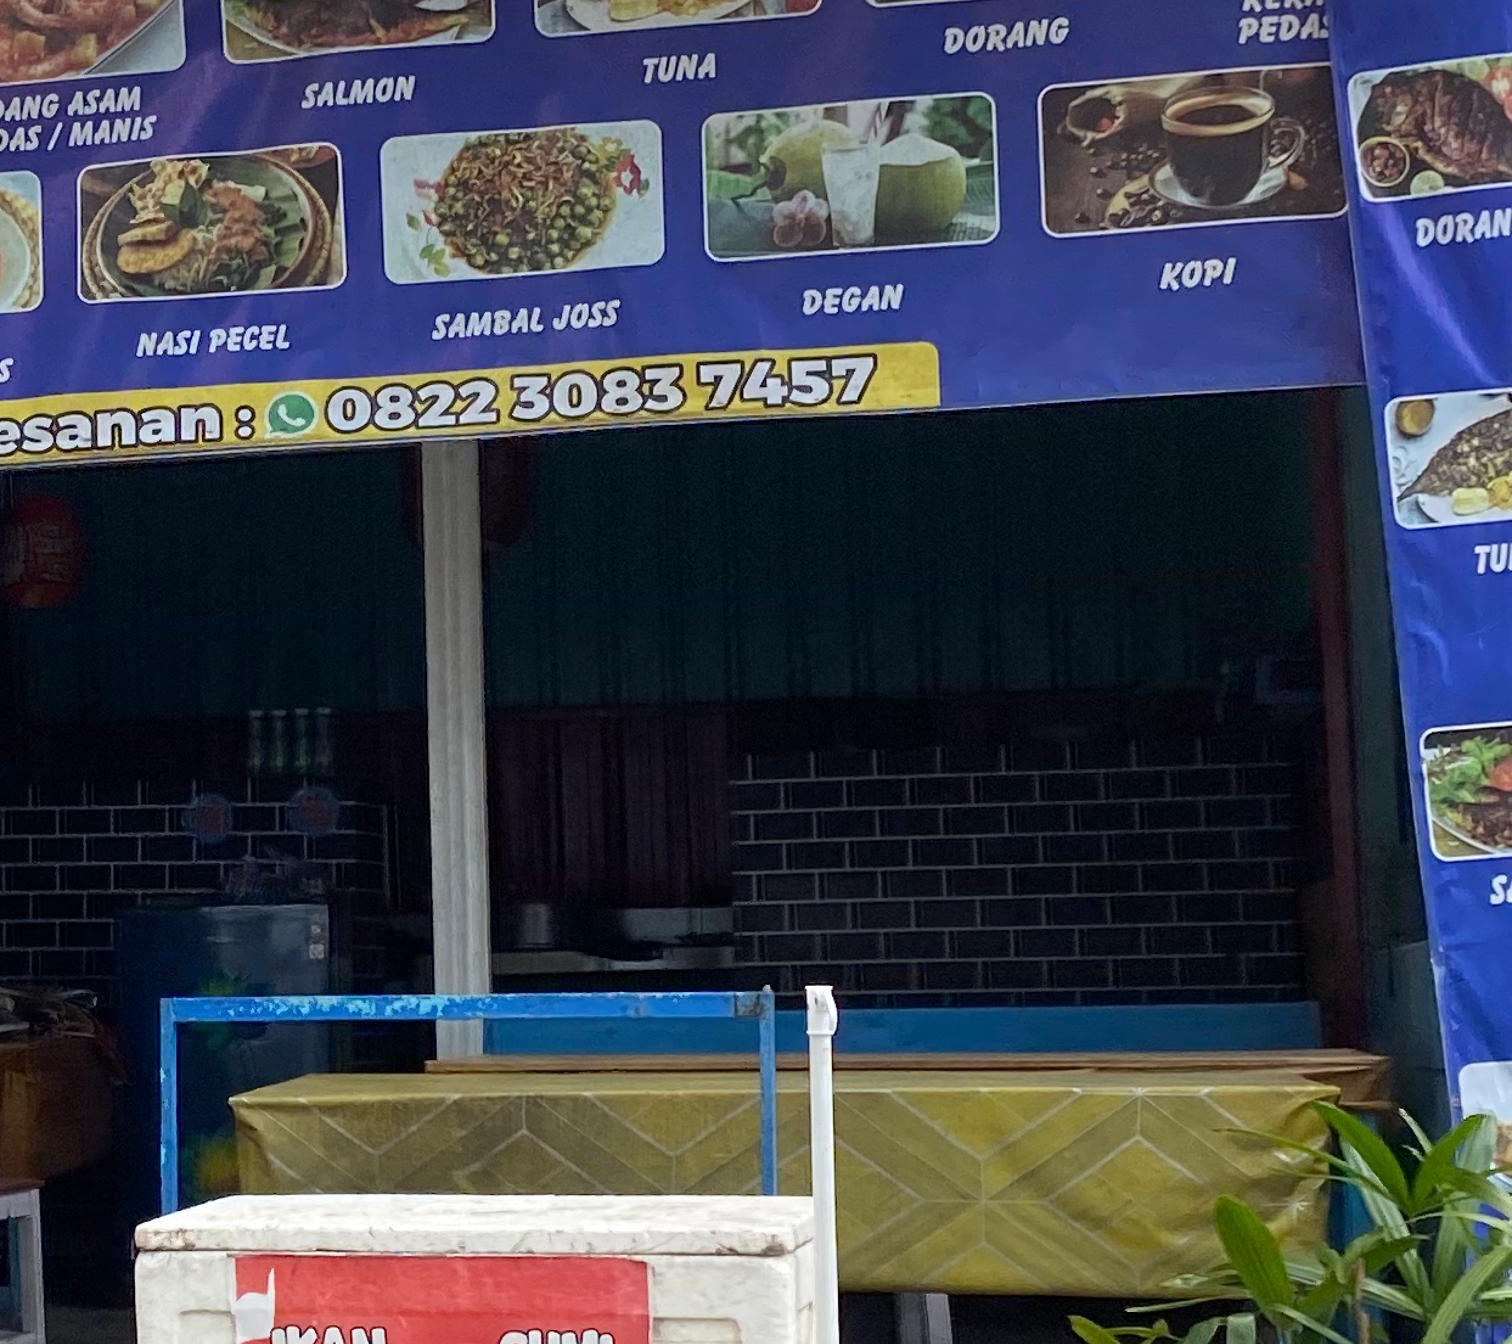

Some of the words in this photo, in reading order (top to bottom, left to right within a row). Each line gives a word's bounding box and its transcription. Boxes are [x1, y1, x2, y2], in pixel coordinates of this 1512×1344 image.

[944, 17, 1069, 54] DORANG
[643, 53, 717, 84] TUNA
[67, 86, 142, 115] ASAM
[301, 74, 415, 109] SALMON
[68, 115, 157, 148] MANIS
[1415, 207, 1512, 248] DORAN
[1158, 258, 1236, 292] KOPI
[802, 284, 904, 316] DEGAN
[431, 309, 544, 342] SAMBAL
[553, 299, 621, 330] JOSS
[136, 329, 200, 358] NASI
[209, 324, 290, 353] PECEL
[325, 387, 499, 436] 0822
[511, 365, 684, 425] 3083
[697, 355, 878, 410] 7457
[1474, 542, 1512, 575] TU
